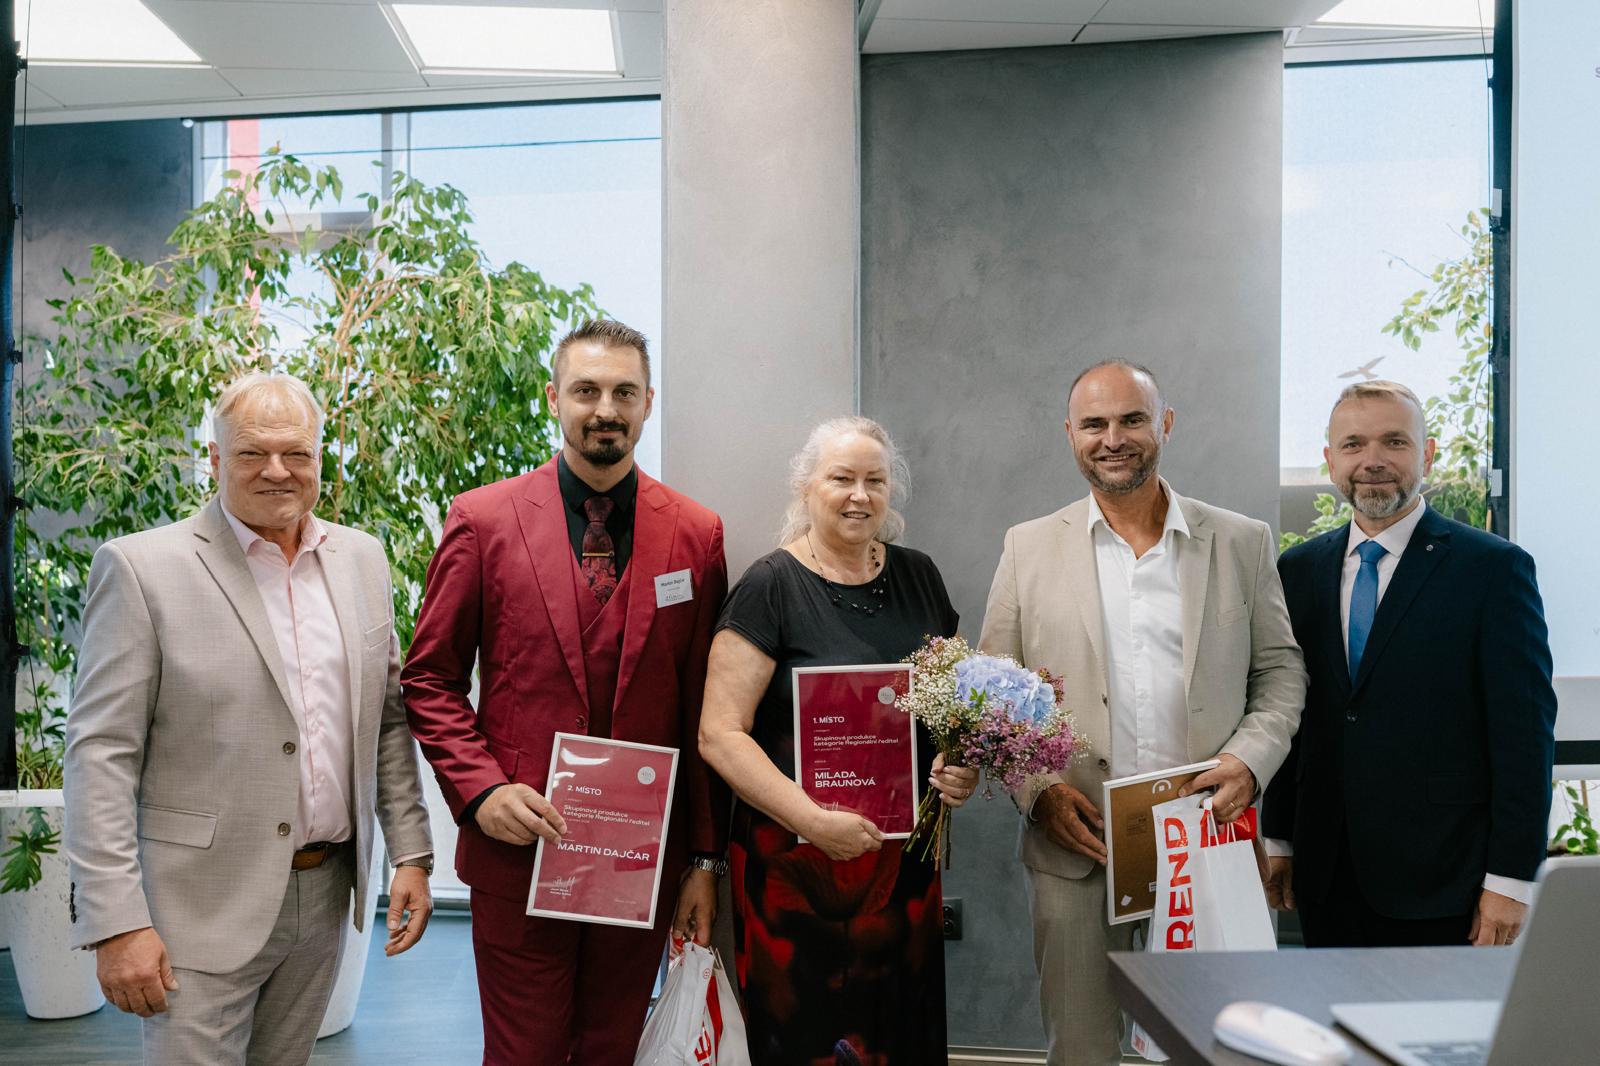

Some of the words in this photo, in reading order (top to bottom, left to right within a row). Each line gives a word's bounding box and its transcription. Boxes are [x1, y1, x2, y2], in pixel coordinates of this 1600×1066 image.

[813, 740, 844, 748] kategorie
[815, 771, 856, 779] MILADA
[815, 776, 876, 788] BRAUNOVÁ
[567, 784, 574, 792] 2.
[575, 785, 602, 796] MÍSTO
[562, 810, 595, 821] kategorie
[598, 807, 629, 818] produkce
[557, 842, 602, 855] MARTIN
[603, 848, 650, 861] DAJČAR
